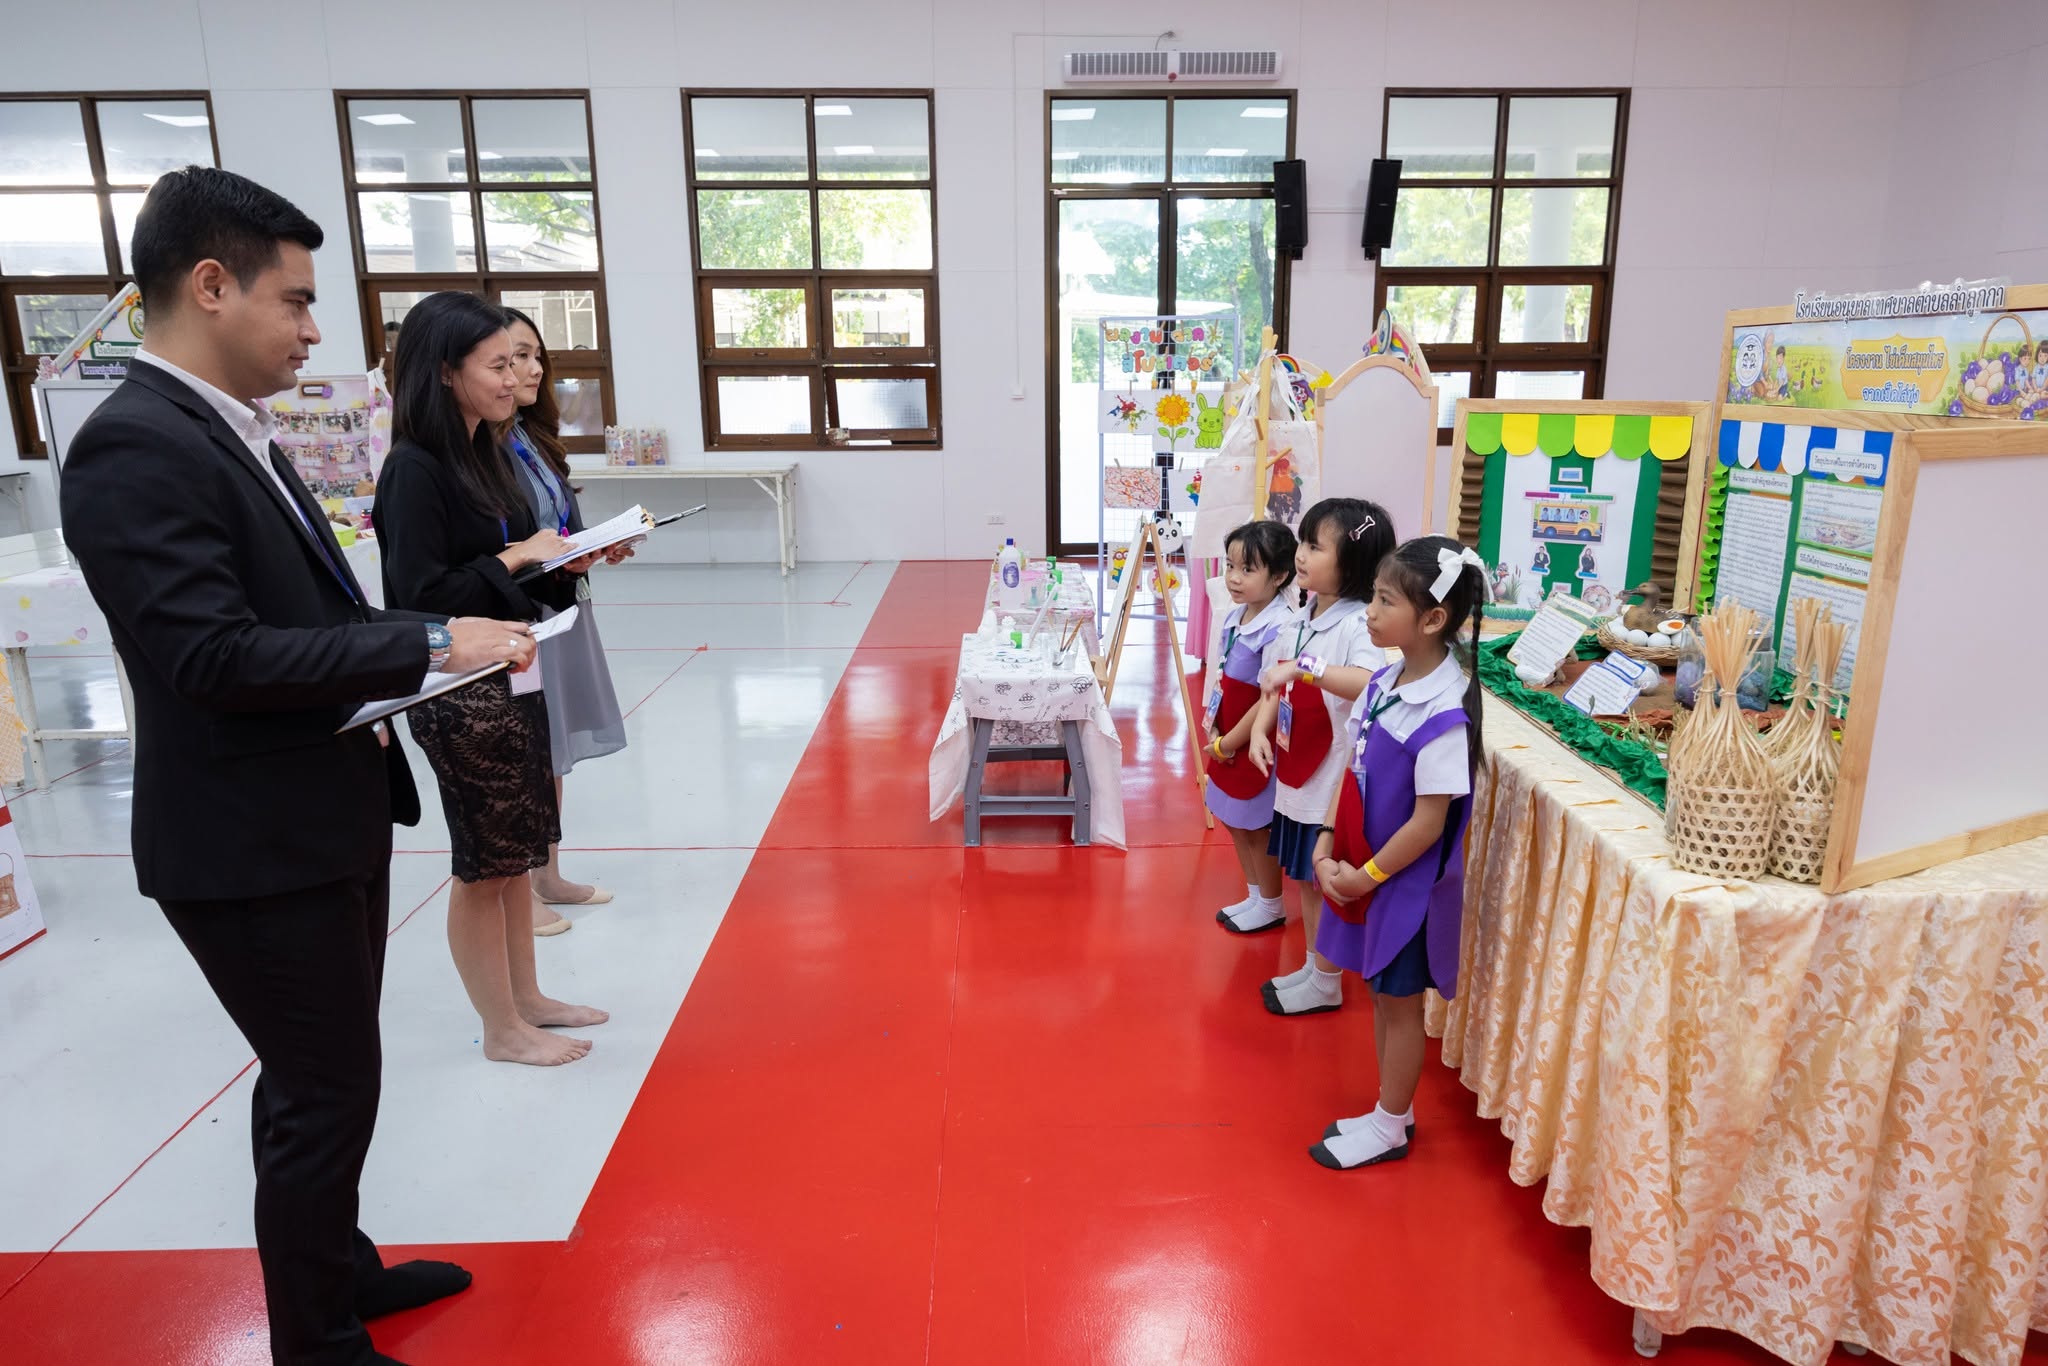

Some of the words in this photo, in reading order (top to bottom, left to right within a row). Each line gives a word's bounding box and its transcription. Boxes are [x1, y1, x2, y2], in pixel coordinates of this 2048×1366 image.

[1795, 284, 2005, 324] โรงเรียนอนุบาลเทศบาลตำบลลำลูกกา
[1105, 327, 1163, 344] ผลงาน
[1171, 327, 1205, 342] จาก
[1846, 346, 1883, 369] โครงงาน
[1884, 344, 1944, 376] ไข่เค็มสมุนไพร
